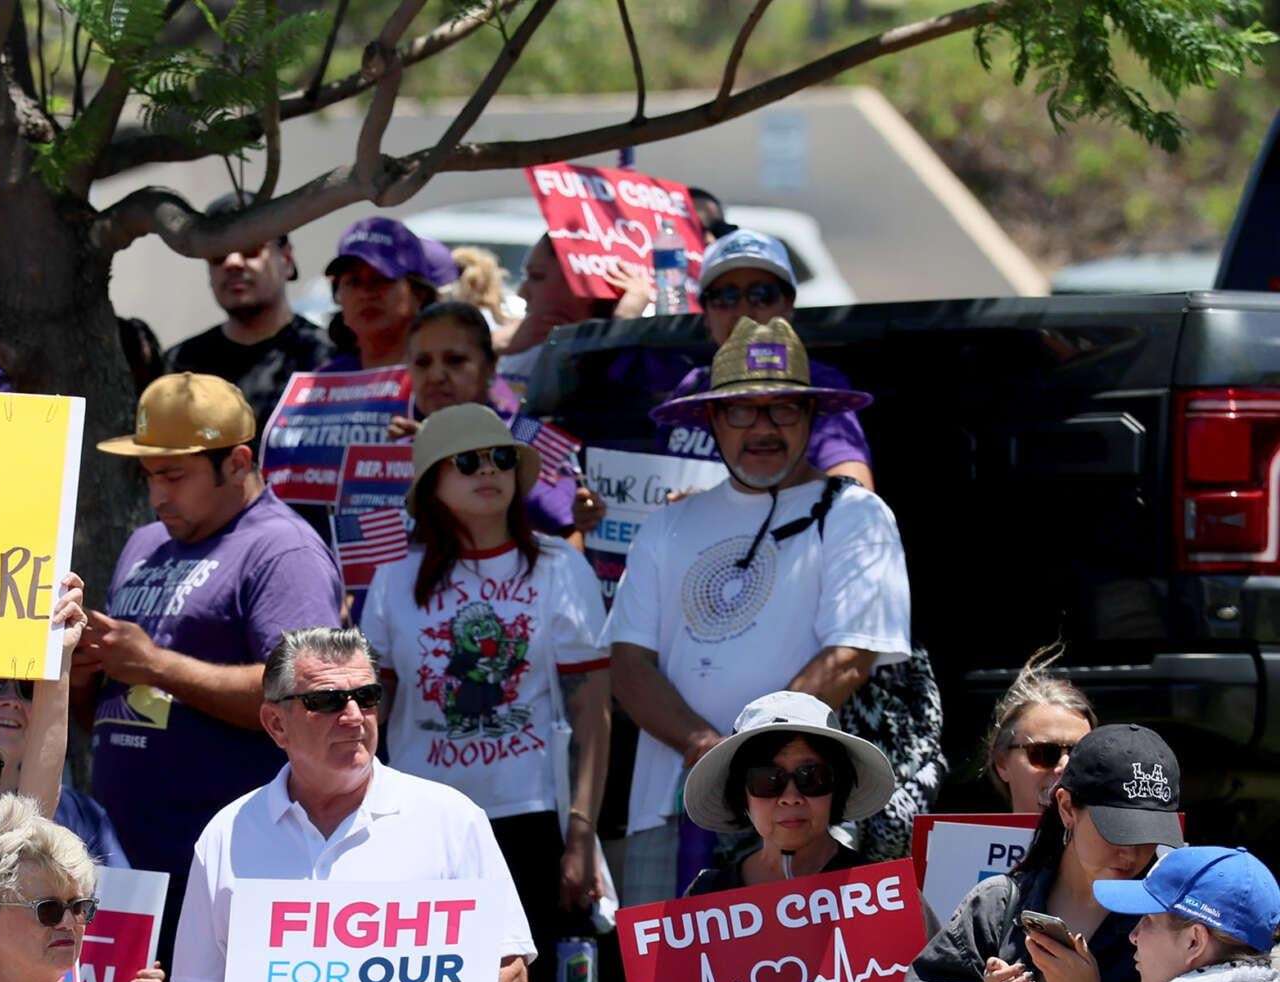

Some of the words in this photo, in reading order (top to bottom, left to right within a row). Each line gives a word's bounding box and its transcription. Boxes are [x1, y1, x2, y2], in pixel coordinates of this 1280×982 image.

[534, 169, 616, 202] FUND
[618, 180, 689, 216] CARE
[354, 460, 384, 478] REP.
[386, 460, 416, 478] YOU
[481, 577, 538, 605] ONLY
[427, 723, 545, 768] NOODLES
[1132, 762, 1167, 784] L.A.
[1123, 780, 1171, 802] TACO
[987, 842, 1026, 867] PR
[269, 899, 477, 949] FIGHT
[633, 902, 764, 956] FUND
[776, 875, 905, 929] CARE
